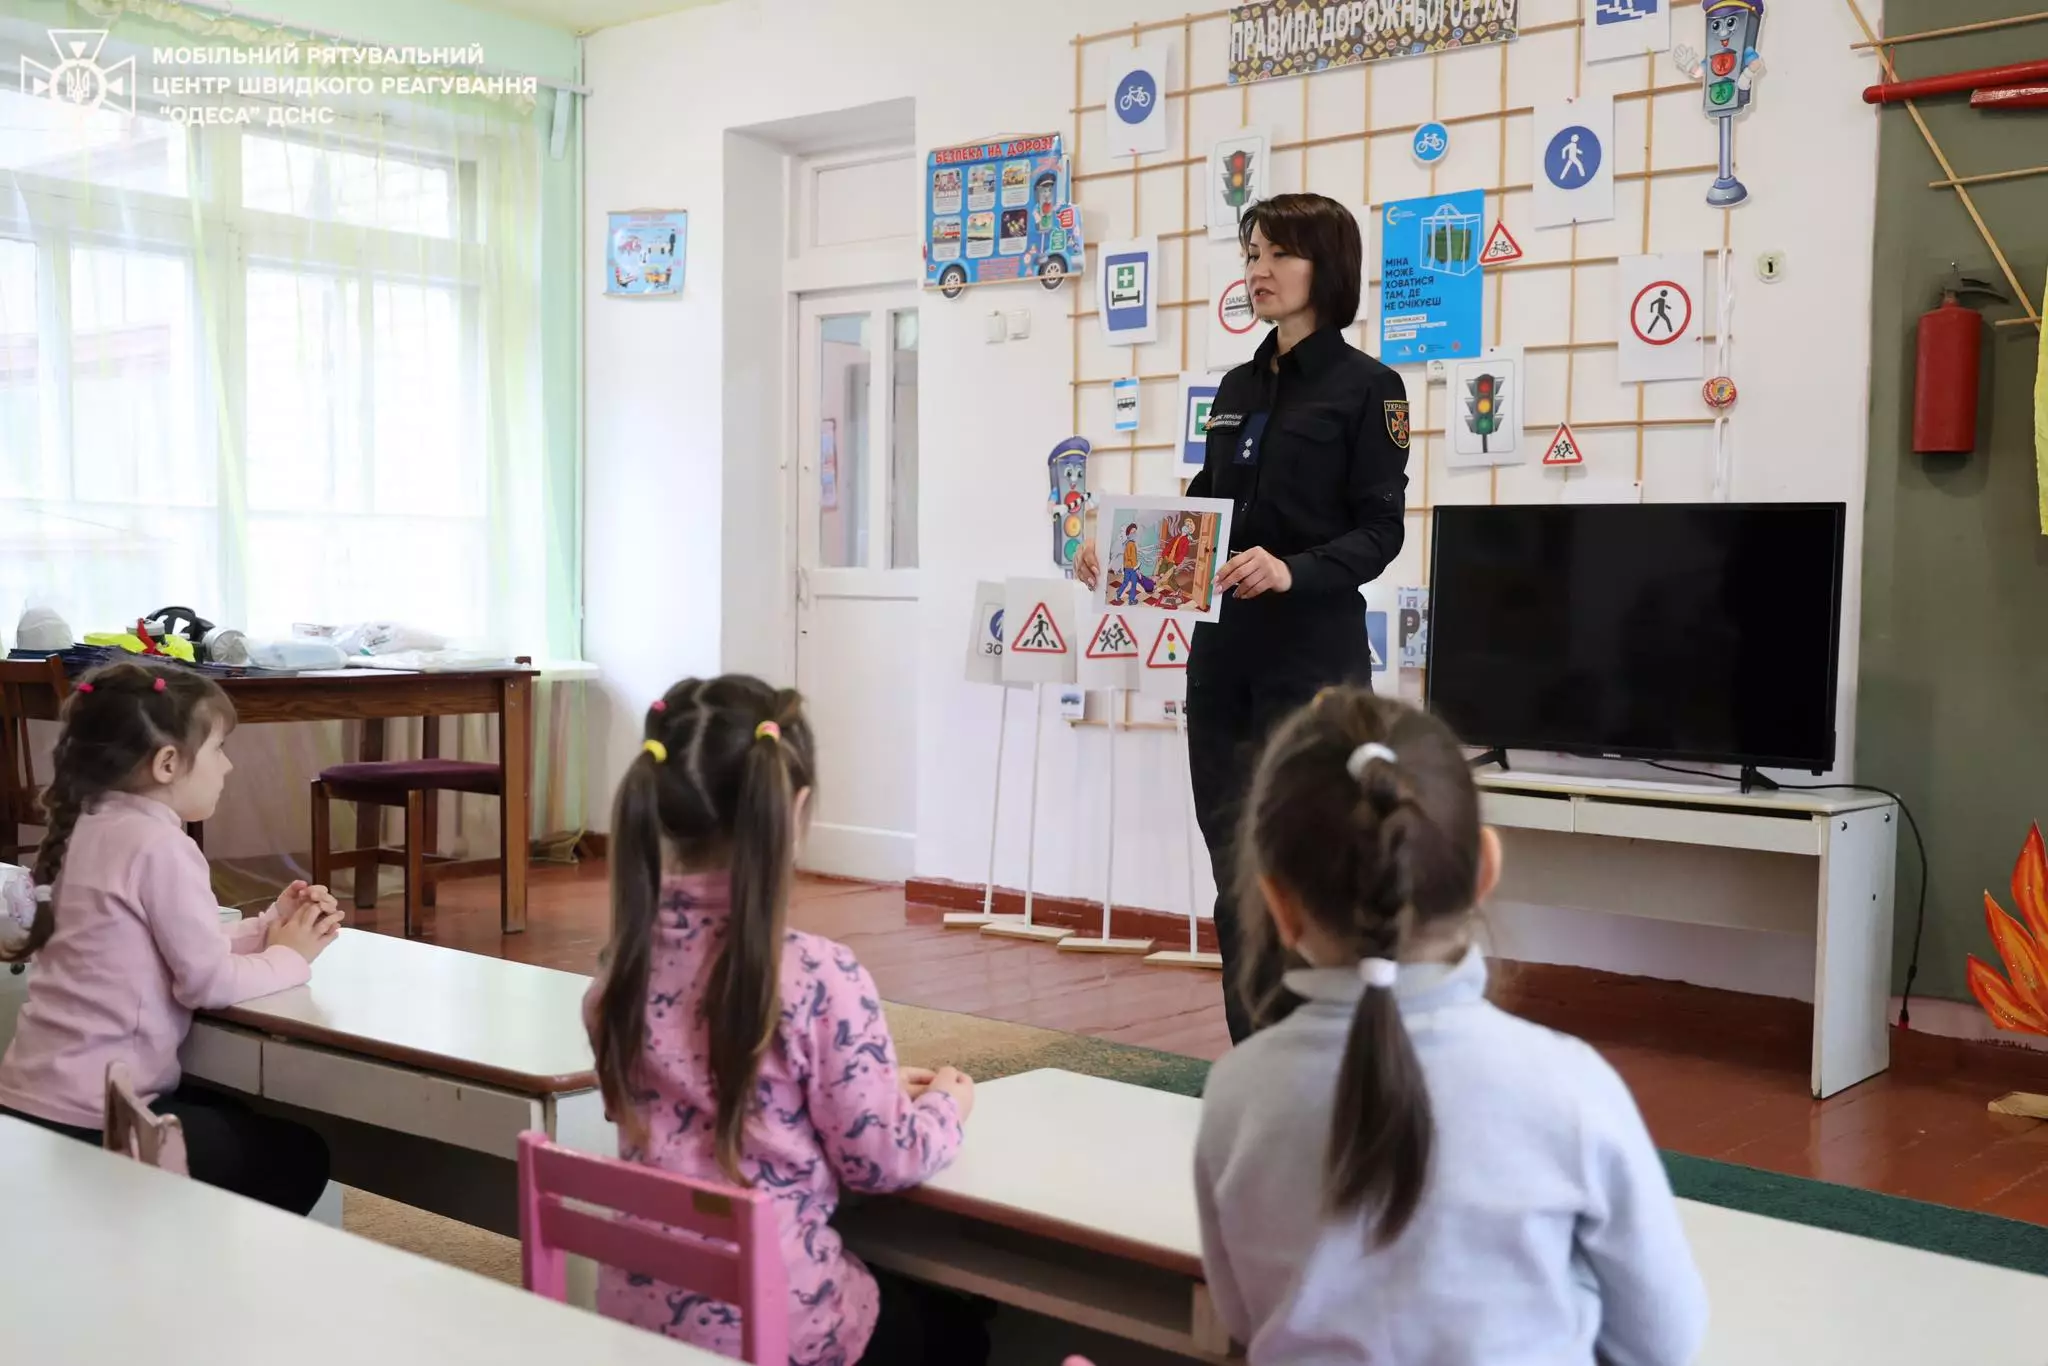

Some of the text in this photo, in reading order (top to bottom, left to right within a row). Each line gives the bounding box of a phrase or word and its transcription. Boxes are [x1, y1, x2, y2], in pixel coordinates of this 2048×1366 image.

[1231, 8, 1319, 62] ПРАВИЛА
[935, 146, 983, 164] БЕЗПЕКА
[987, 143, 1003, 158] НА
[1385, 257, 1409, 268] МІНА
[1385, 267, 1414, 278] МОЖЕ
[1385, 276, 1434, 289] ХОВАТИСЯ
[1408, 288, 1421, 298] ДЕ
[1384, 297, 1442, 311] НЕ ОЧІКУЄШ
